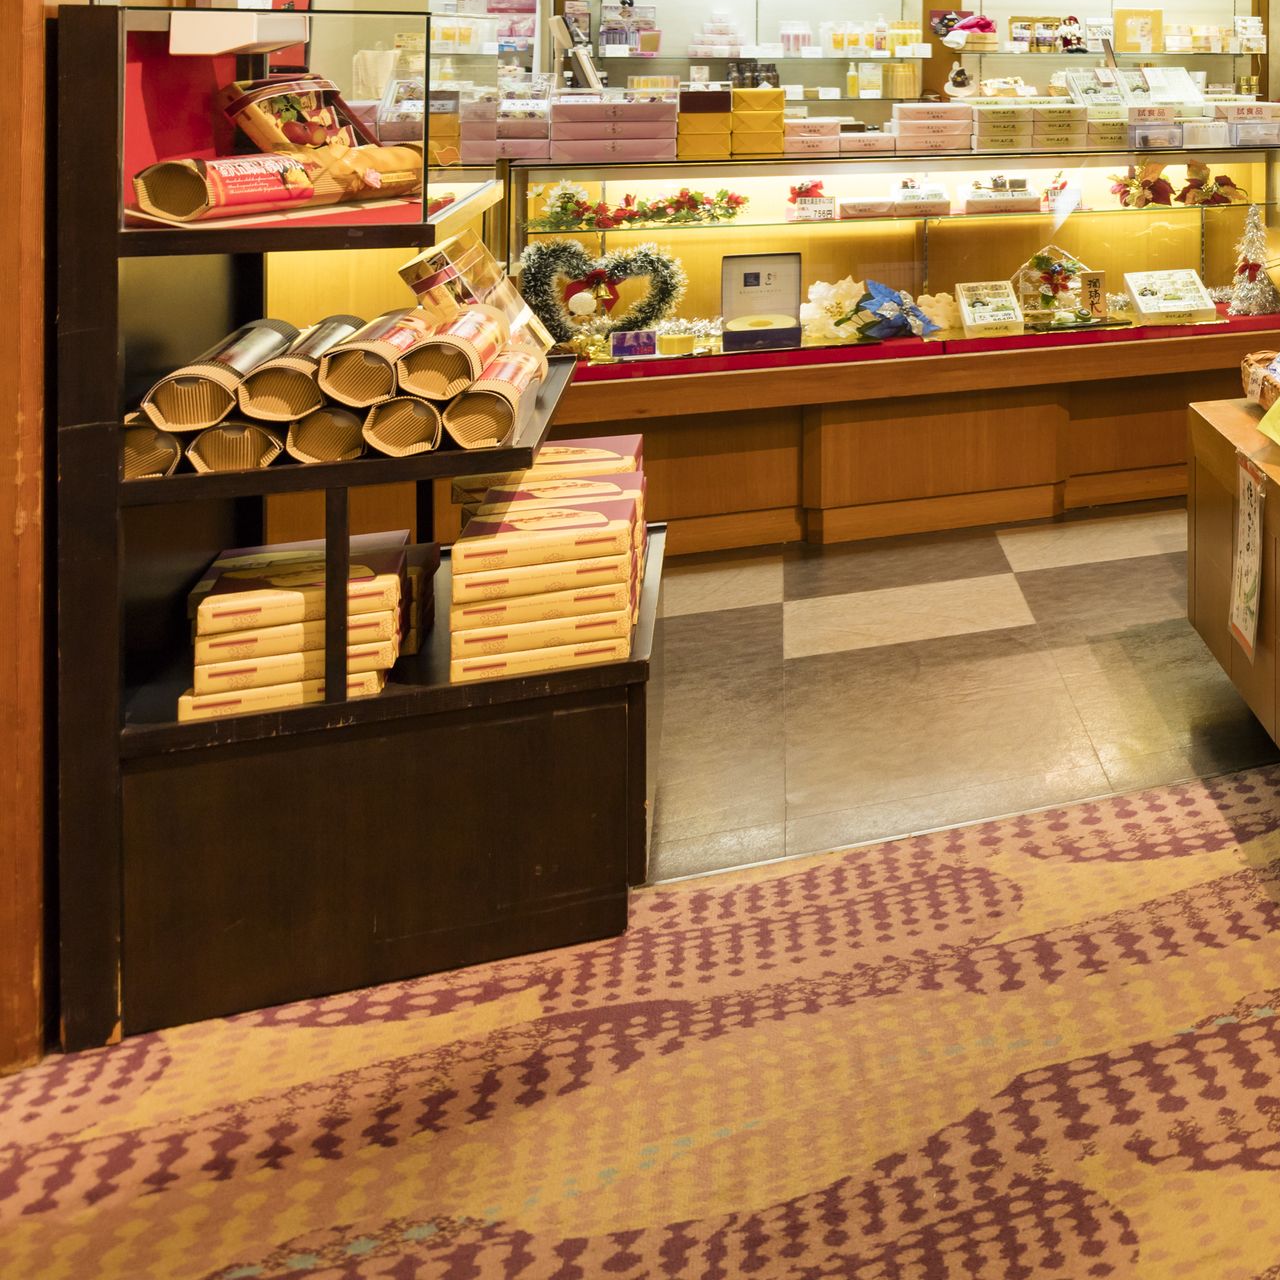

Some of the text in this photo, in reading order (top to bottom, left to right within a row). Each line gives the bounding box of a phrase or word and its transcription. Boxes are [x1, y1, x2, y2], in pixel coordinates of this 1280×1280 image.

[1137, 108, 1166, 117] 試食品
[1236, 107, 1264, 115] 試食品
